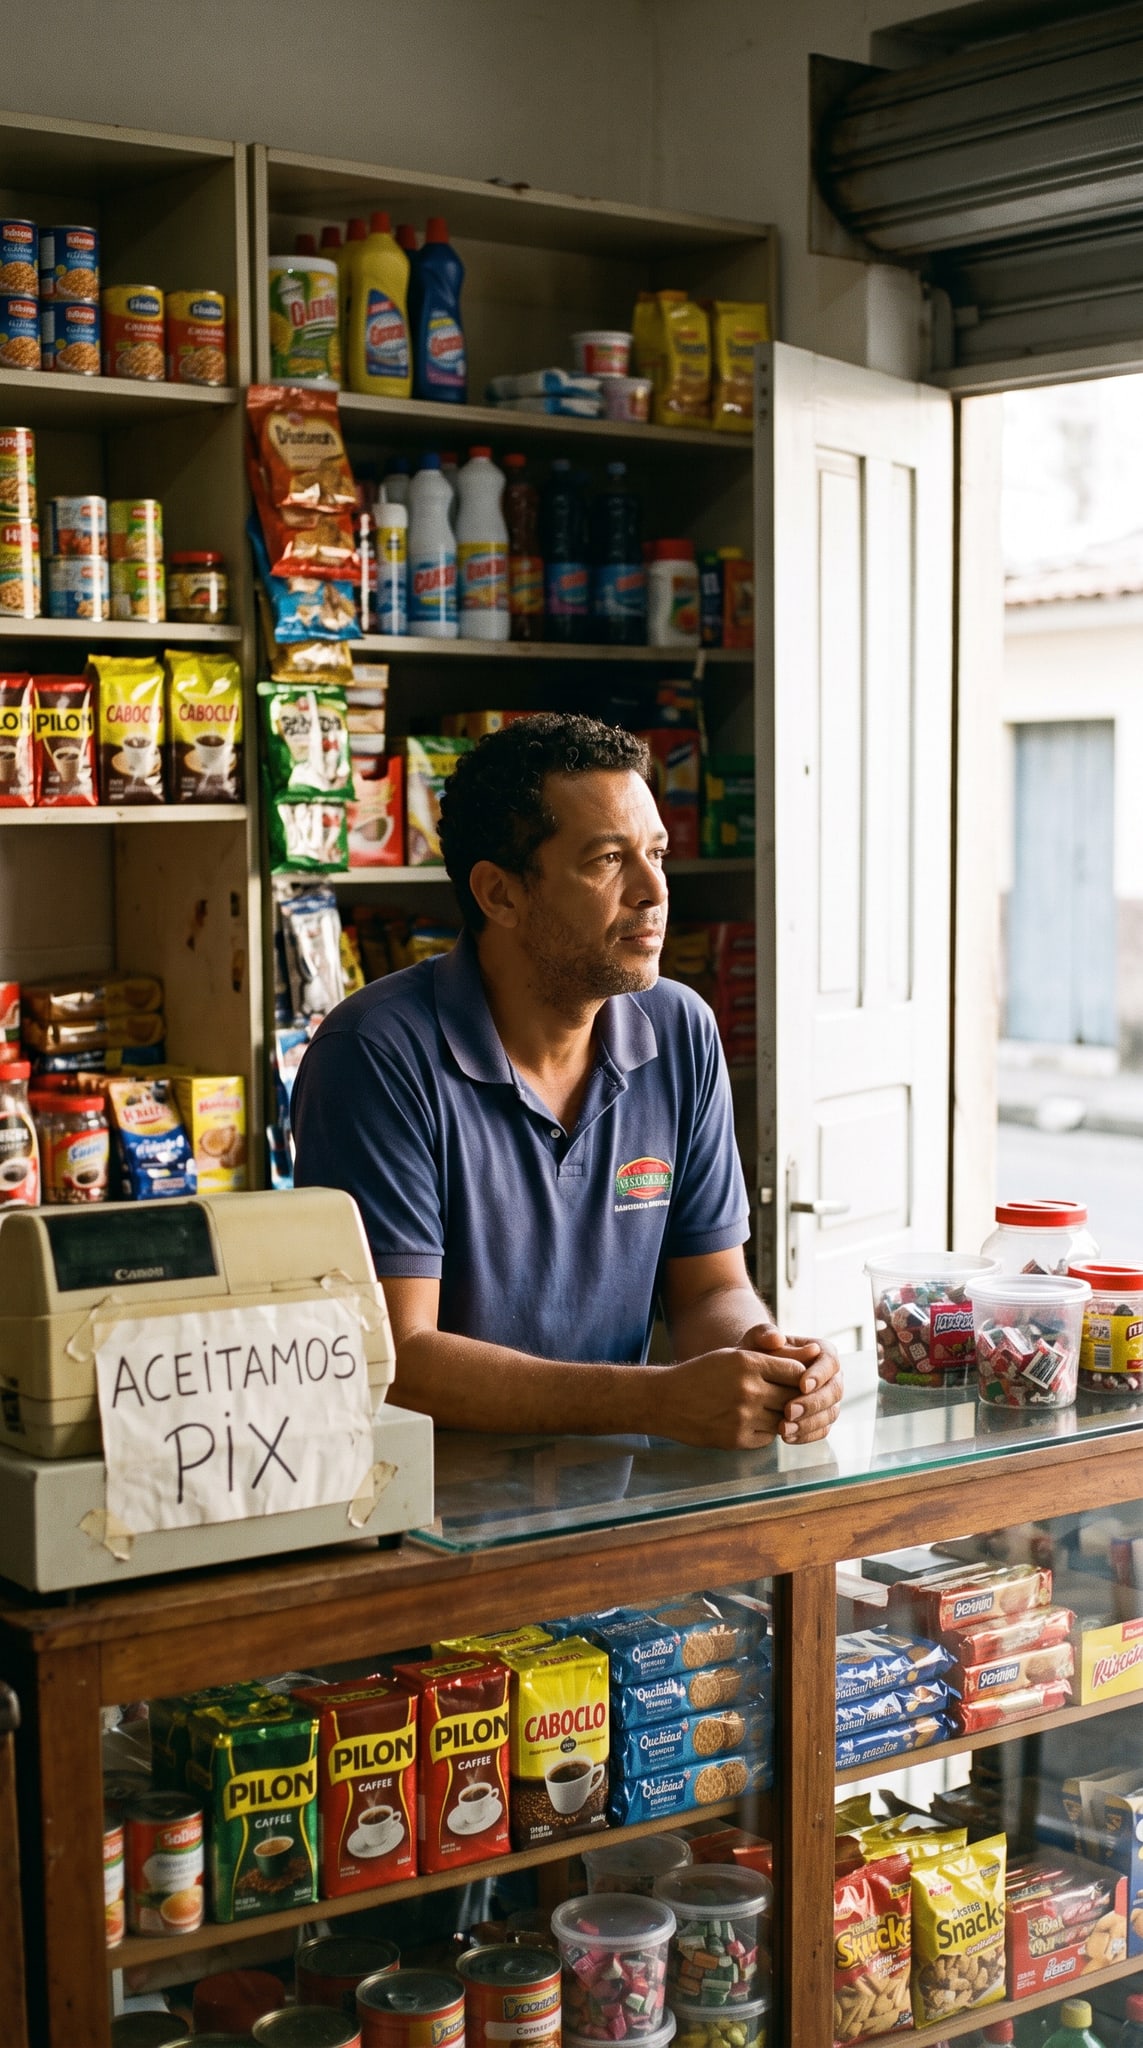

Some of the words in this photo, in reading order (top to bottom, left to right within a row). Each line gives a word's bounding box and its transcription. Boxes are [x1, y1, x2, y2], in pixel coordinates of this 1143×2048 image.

[112, 1334, 357, 1409] ACEITAMOS
[164, 1410, 298, 1505] PIX
[435, 1712, 510, 1751] PILON
[524, 1702, 606, 1743] CABOCLO
[334, 1733, 413, 1774] PILON
[458, 1755, 491, 1771] CAFFEE
[229, 1770, 314, 1809] PILON
[358, 1777, 393, 1793] CAFFEE
[255, 1814, 292, 1829] CAFFEE
[936, 1901, 1005, 1949] Snacks
